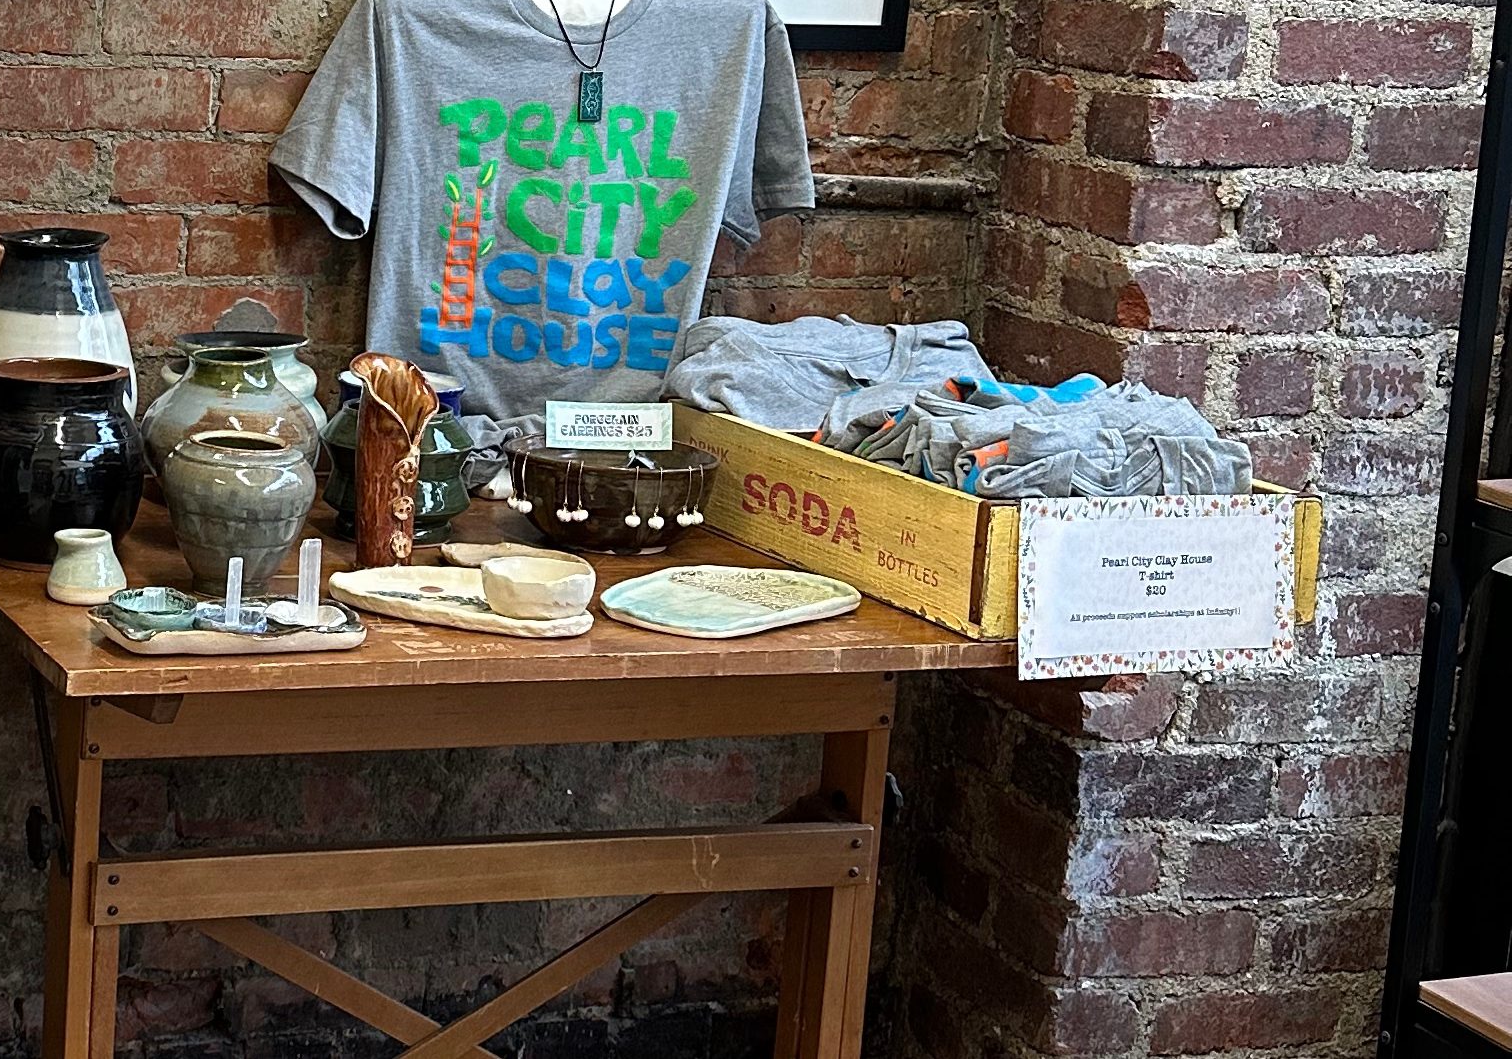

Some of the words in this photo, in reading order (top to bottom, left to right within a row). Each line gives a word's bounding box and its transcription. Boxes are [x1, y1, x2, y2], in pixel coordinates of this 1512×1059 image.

[575, 414, 639, 424] PORCELAIN
[560, 425, 623, 437] EARRINGS
[626, 425, 653, 437] $25
[741, 473, 863, 554] SODA
[900, 528, 916, 548] IN
[877, 549, 939, 587] BOTTLES
[1101, 556, 1129, 568] Pearl
[1131, 556, 1153, 568] City
[1155, 555, 1178, 567] Clay
[1181, 554, 1213, 565] House
[1139, 570, 1174, 581] T-shirt
[1146, 584, 1166, 596] $20
[1070, 614, 1081, 622] All
[1082, 612, 1115, 622] proceeds
[1116, 610, 1146, 621] support
[1148, 609, 1195, 619] scholarships
[1197, 608, 1204, 616] at
